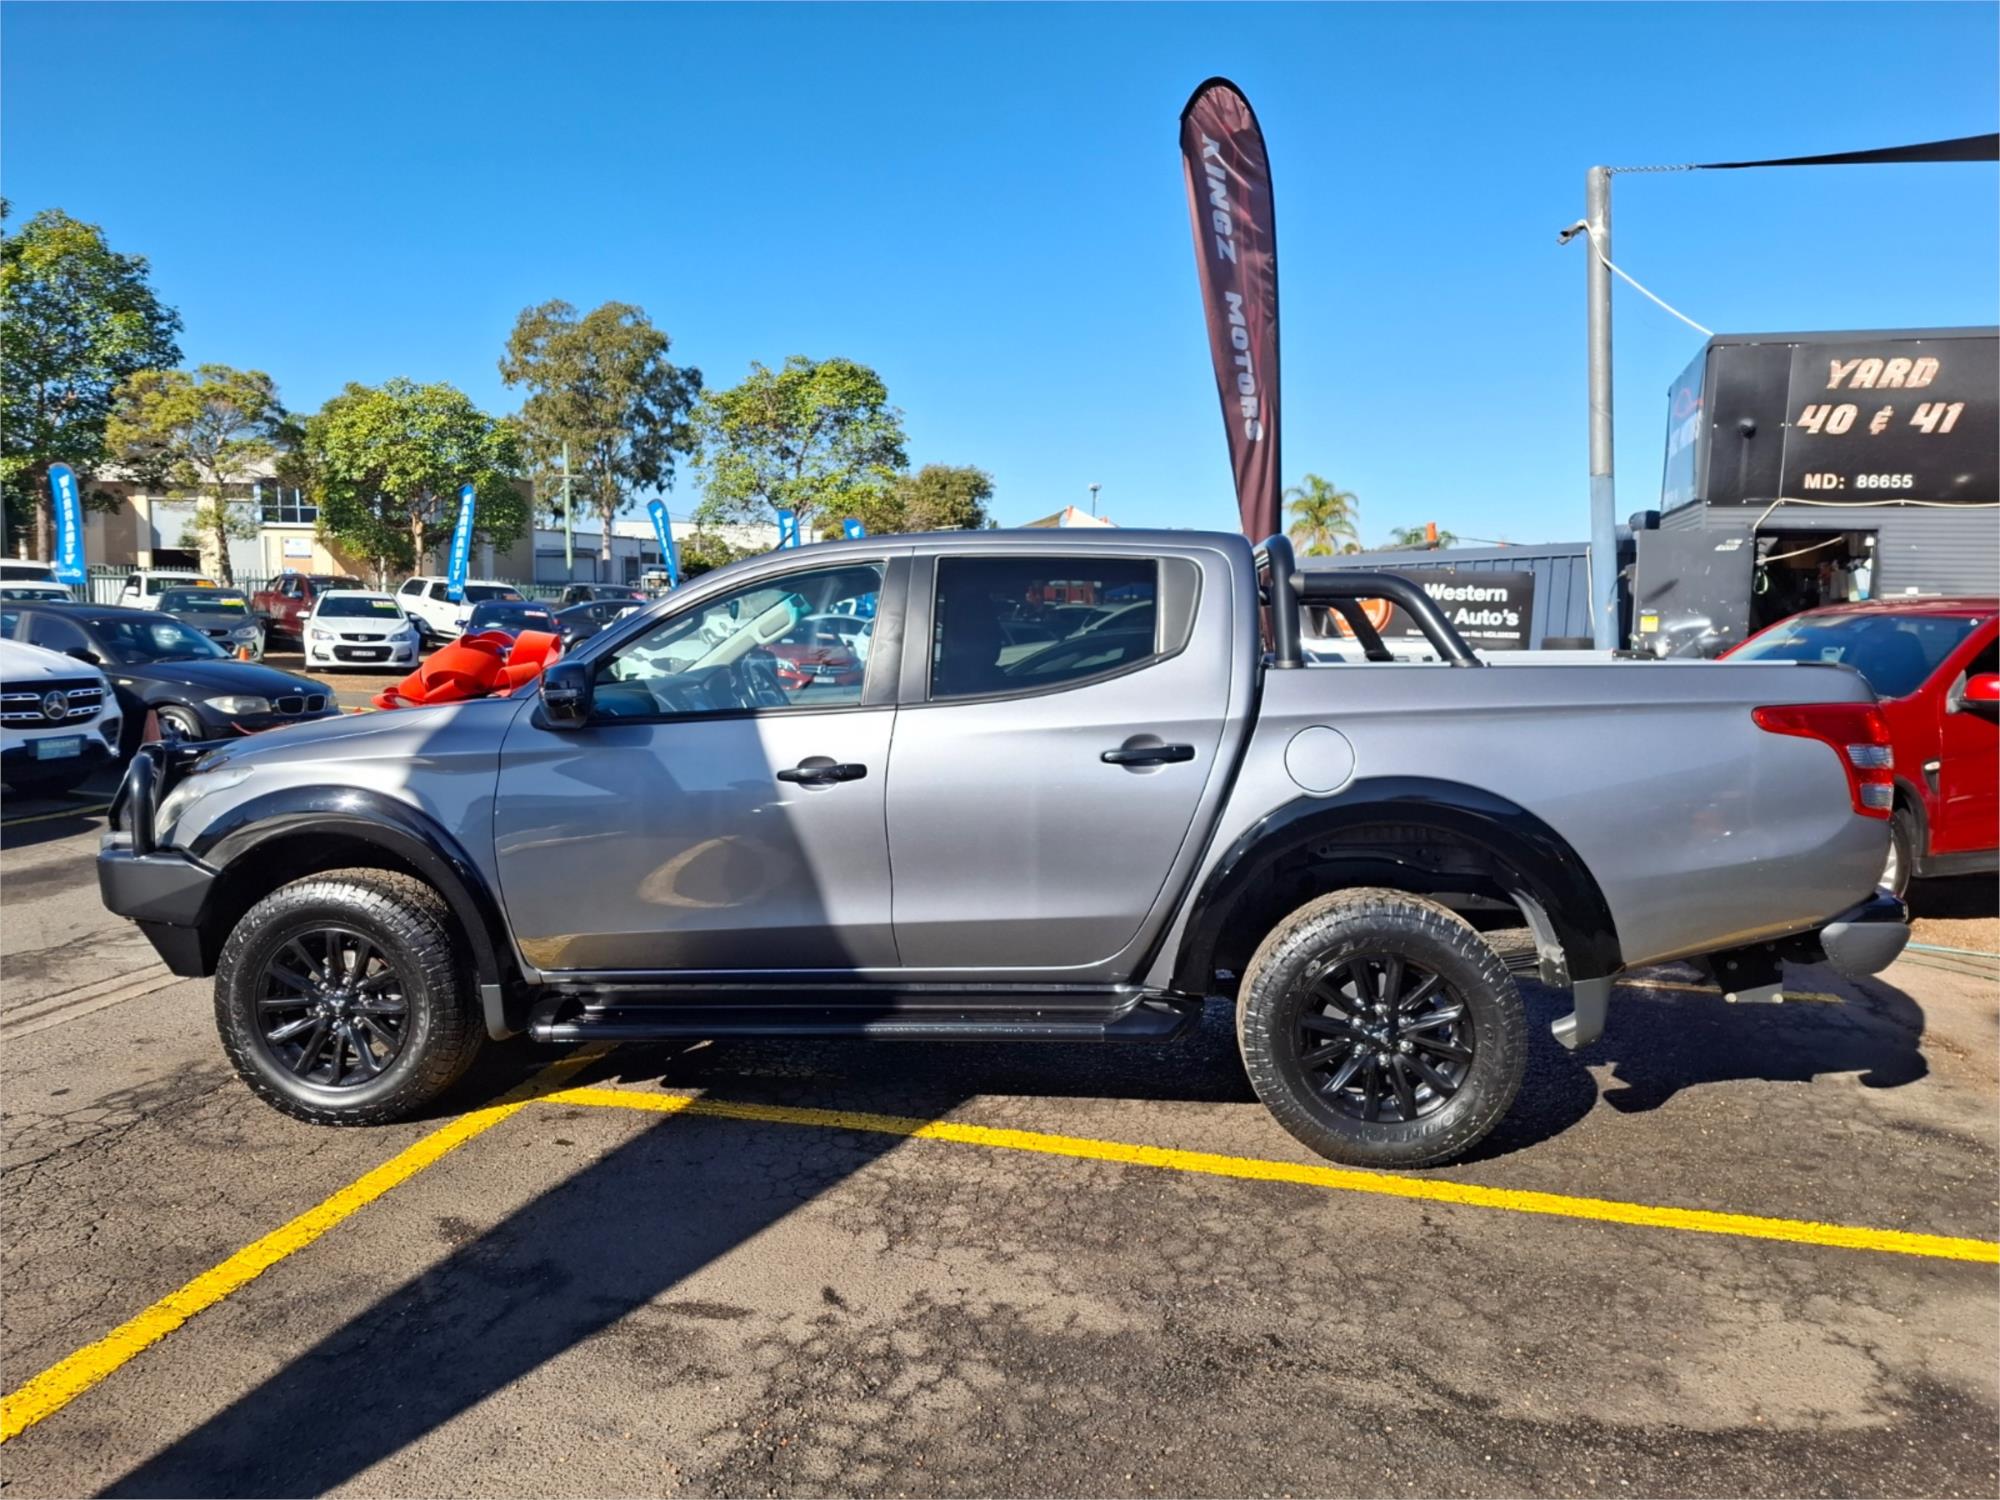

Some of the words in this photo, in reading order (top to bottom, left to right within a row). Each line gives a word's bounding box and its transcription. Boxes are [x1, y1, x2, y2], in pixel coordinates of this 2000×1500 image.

[1202, 133, 1237, 264] KINGZ
[1225, 291, 1263, 442] MOTORS
[1826, 356, 1941, 389] YARD
[1797, 403, 1859, 435] 40
[1908, 402, 1966, 434] 41
[1803, 473, 1846, 490] MD:
[1856, 473, 1914, 489] 86655
[58, 473, 76, 565] WARRANTY
[453, 493, 472, 581] WARRANTY
[1424, 583, 1508, 602] Western
[1454, 606, 1520, 626] Auto's
